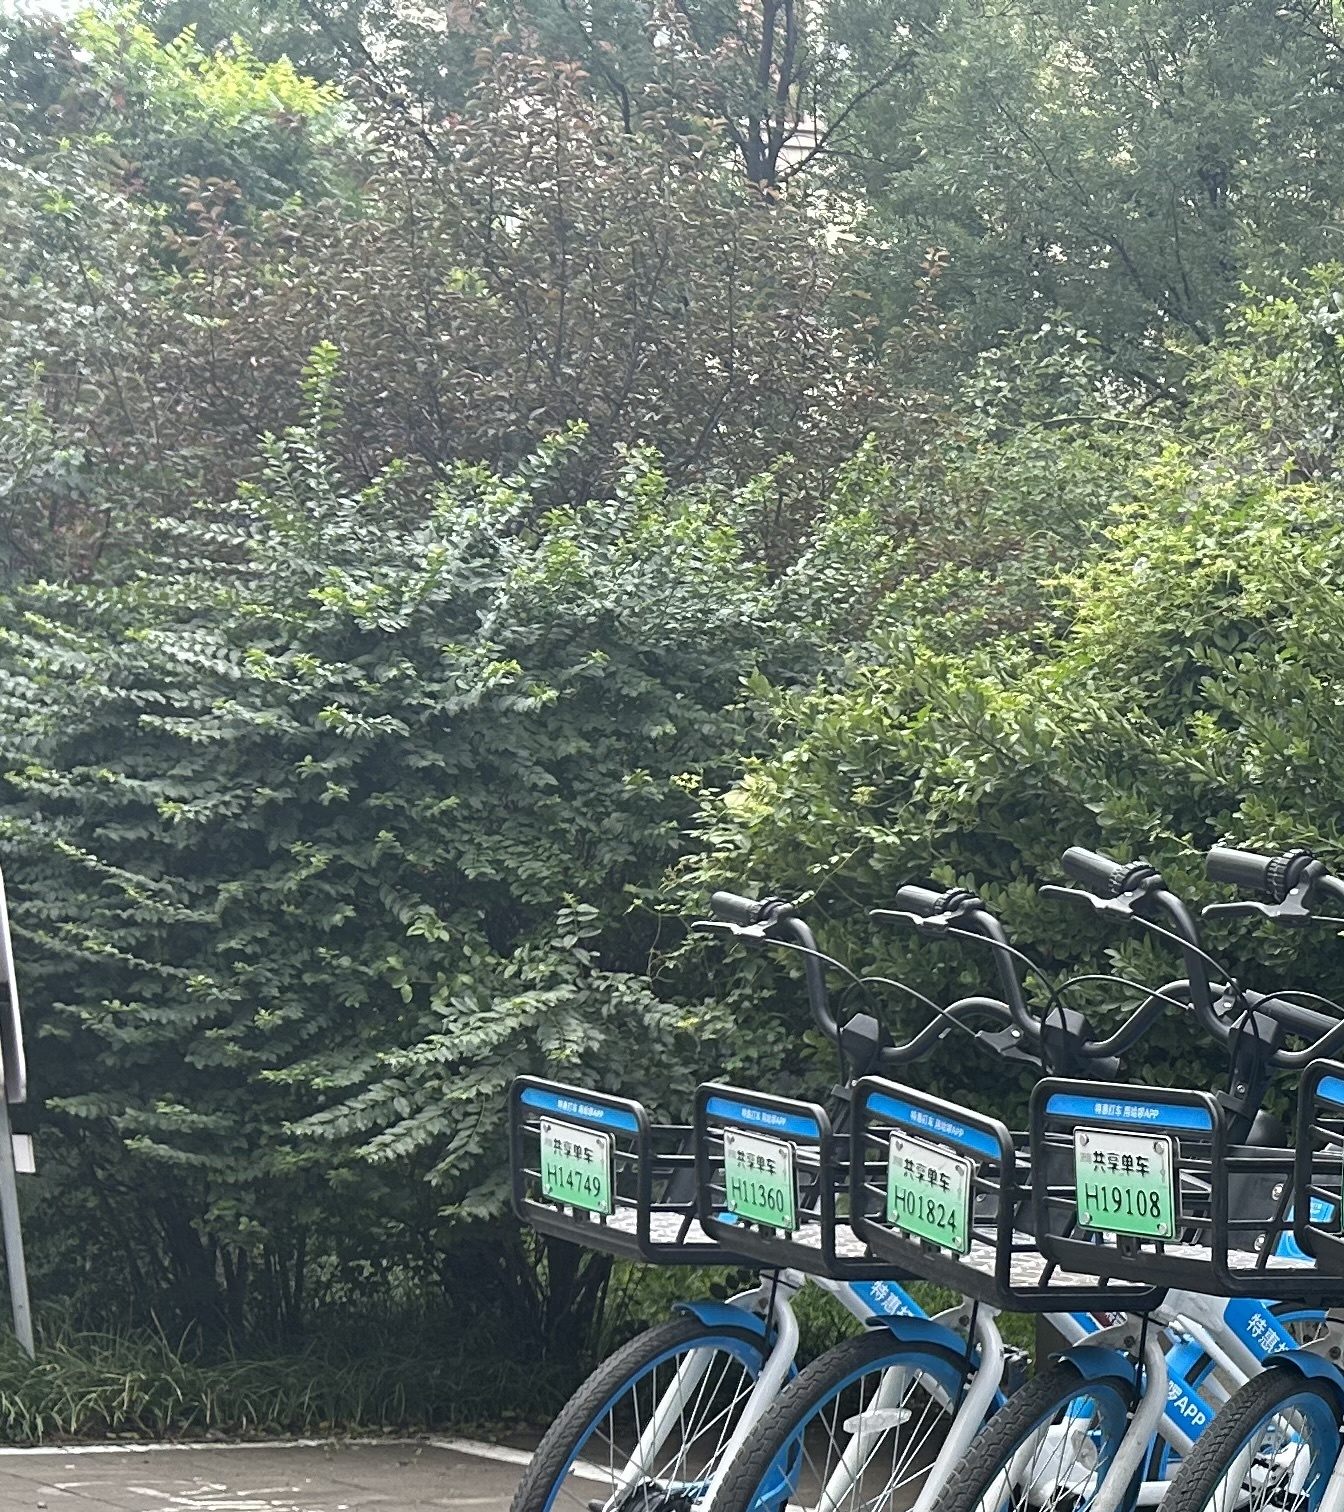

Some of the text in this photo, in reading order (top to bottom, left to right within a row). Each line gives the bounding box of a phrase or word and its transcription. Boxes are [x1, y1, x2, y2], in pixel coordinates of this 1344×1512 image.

[553, 1138, 594, 1163] 共享单车
[736, 1150, 777, 1176] 共享单车
[1093, 1150, 1150, 1177] 共享单车
[547, 1163, 601, 1197] H14749
[903, 1158, 951, 1192] 共享单车
[731, 1176, 784, 1213] H11360
[894, 1185, 957, 1234] H01824
[1084, 1183, 1161, 1218] H19108
